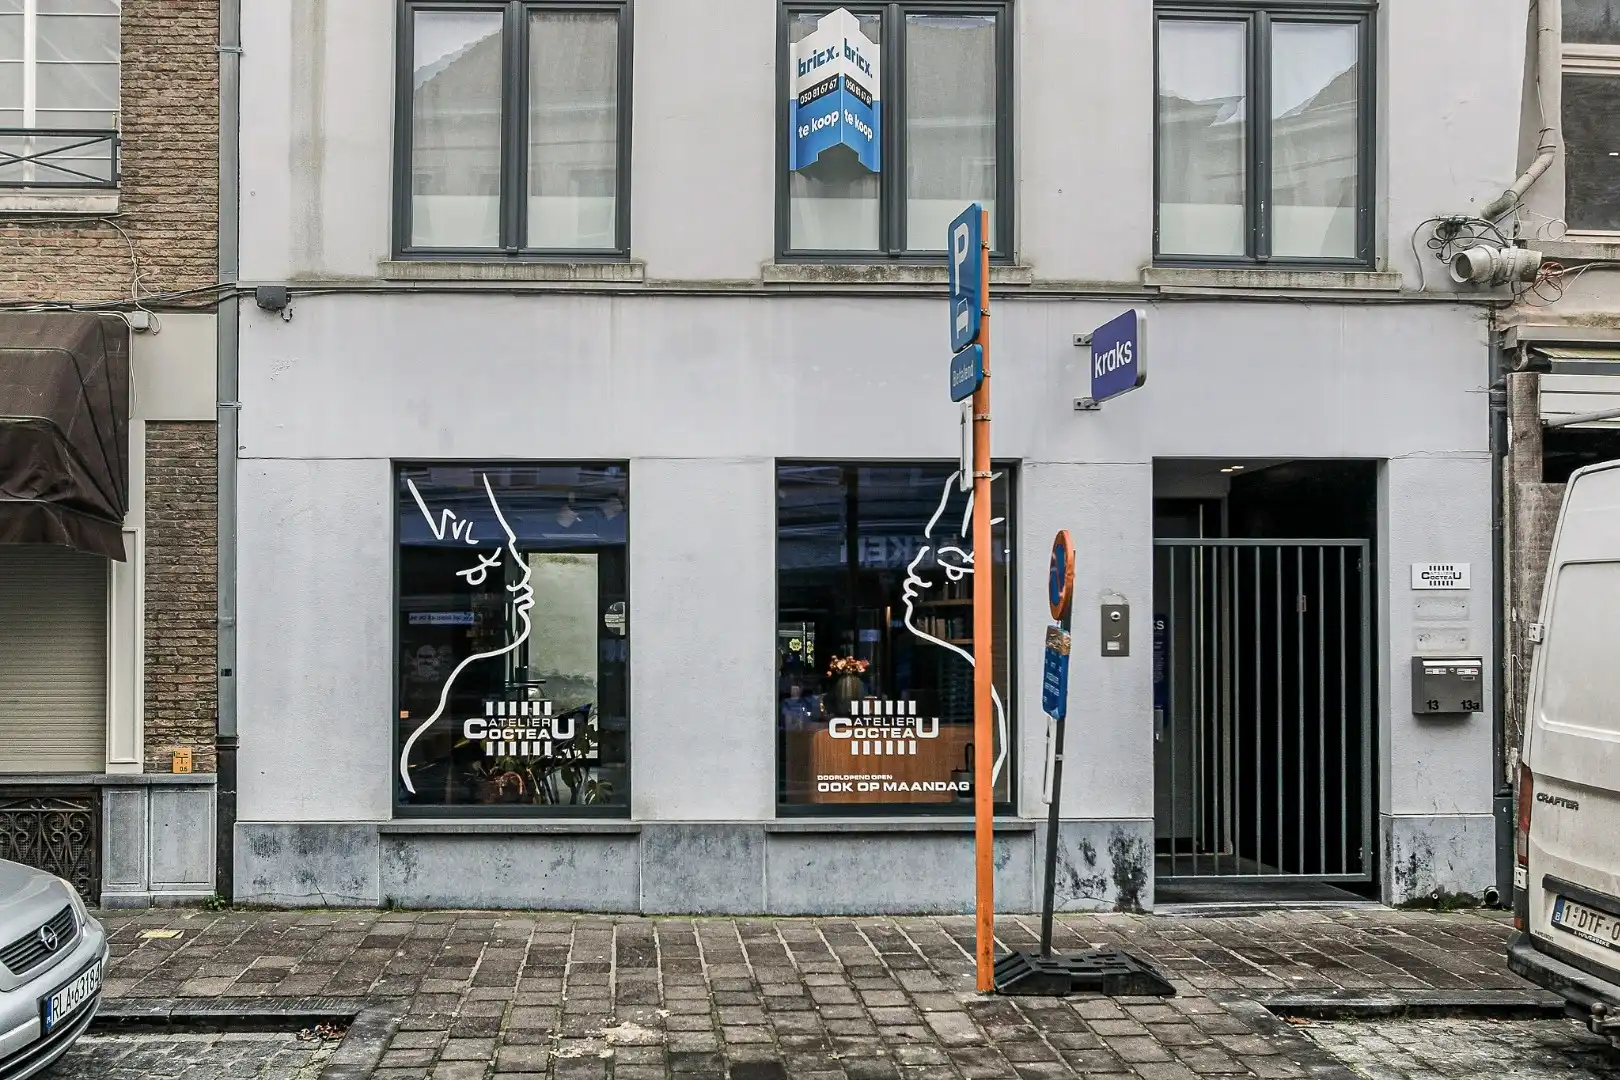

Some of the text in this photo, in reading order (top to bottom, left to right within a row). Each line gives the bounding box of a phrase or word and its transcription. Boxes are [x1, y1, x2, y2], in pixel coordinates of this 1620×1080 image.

[798, 45, 840, 78] bricx.
[844, 37, 873, 79] bricx.
[800, 78, 837, 104] 050 81 67 67
[845, 79, 856, 92] 050
[856, 86, 861, 96] 81
[798, 110, 839, 139] te koop
[844, 109, 873, 141] te koop
[954, 222, 969, 296] P
[1094, 340, 1132, 379] kraks
[1426, 699, 1439, 710] 13
[1461, 699, 1480, 710] 13a
[463, 718, 575, 740] COCTEAU
[488, 718, 551, 727] ATELIER
[828, 717, 939, 739] COCTEAU
[853, 717, 915, 727] ATELIER
[817, 781, 970, 792] OOK OP MAANDAG
[1536, 792, 1579, 811] CRAFTER
